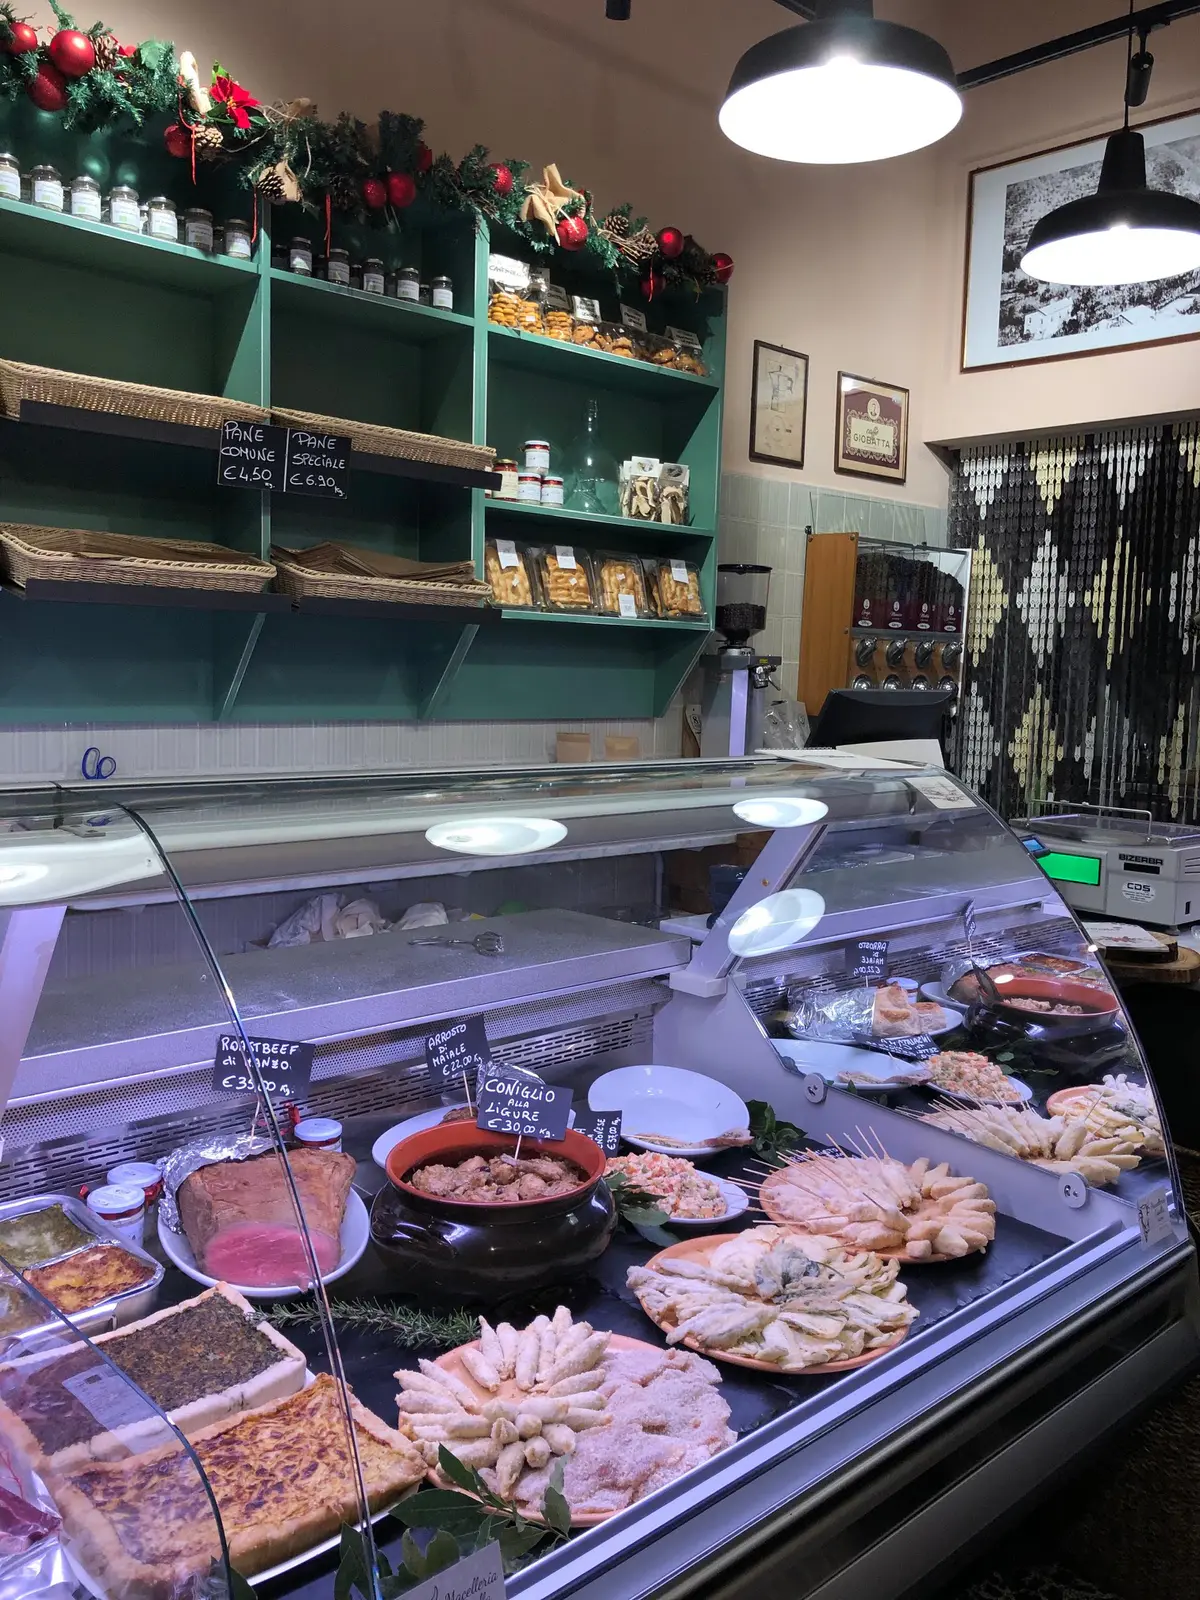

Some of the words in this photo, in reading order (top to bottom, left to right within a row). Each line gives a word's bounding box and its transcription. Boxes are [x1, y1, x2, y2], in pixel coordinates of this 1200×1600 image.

[224, 420, 264, 443] PANE
[292, 432, 337, 450] PANE
[853, 432, 891, 450] GIOBATTA
[221, 446, 276, 462] COMUNE
[1118, 853, 1164, 866] BIZERBA
[1127, 882, 1151, 892] CDS
[221, 1036, 299, 1055] ROASTBEEF
[428, 1023, 467, 1051] ARROSTO
[507, 1098, 530, 1109] ALLA
